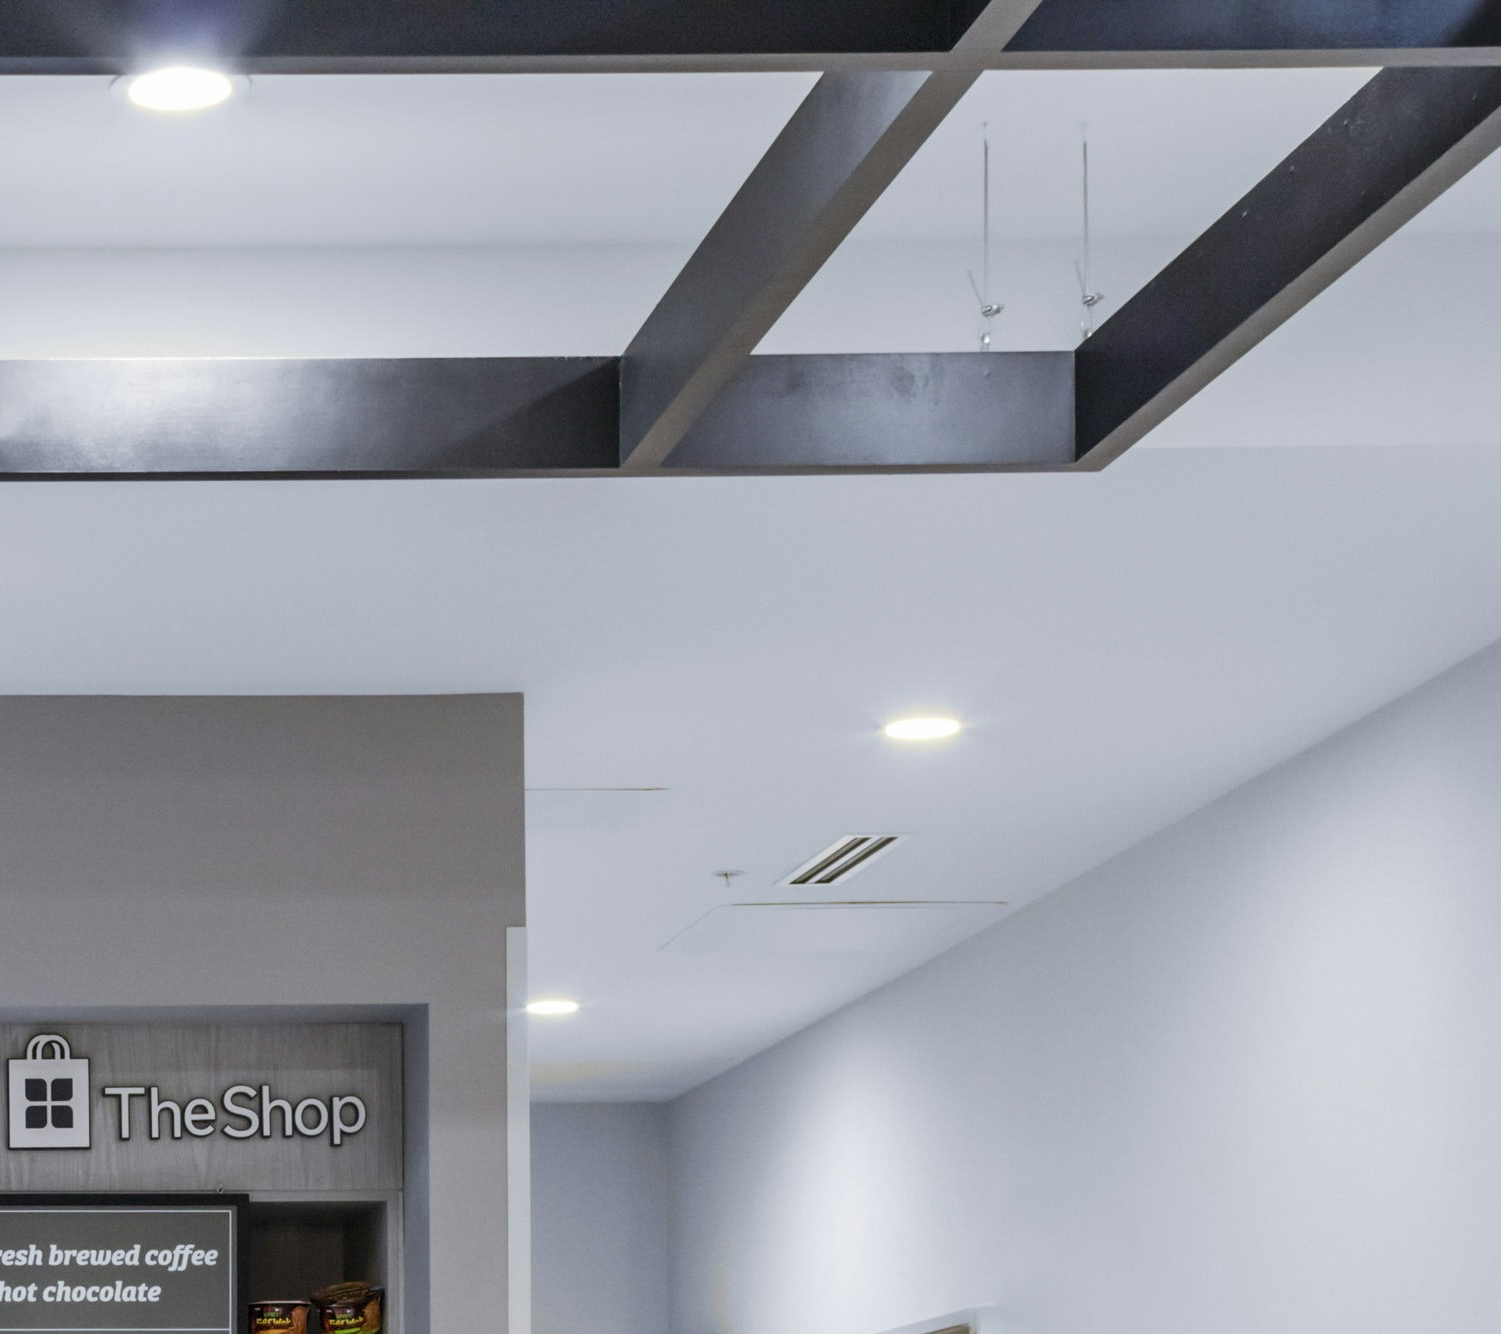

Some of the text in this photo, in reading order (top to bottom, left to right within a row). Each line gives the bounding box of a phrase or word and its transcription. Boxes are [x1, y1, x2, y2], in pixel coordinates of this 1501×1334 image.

[47, 1242, 139, 1268] brewed
[142, 1243, 219, 1271] coffee
[42, 1279, 162, 1305] chocolate
